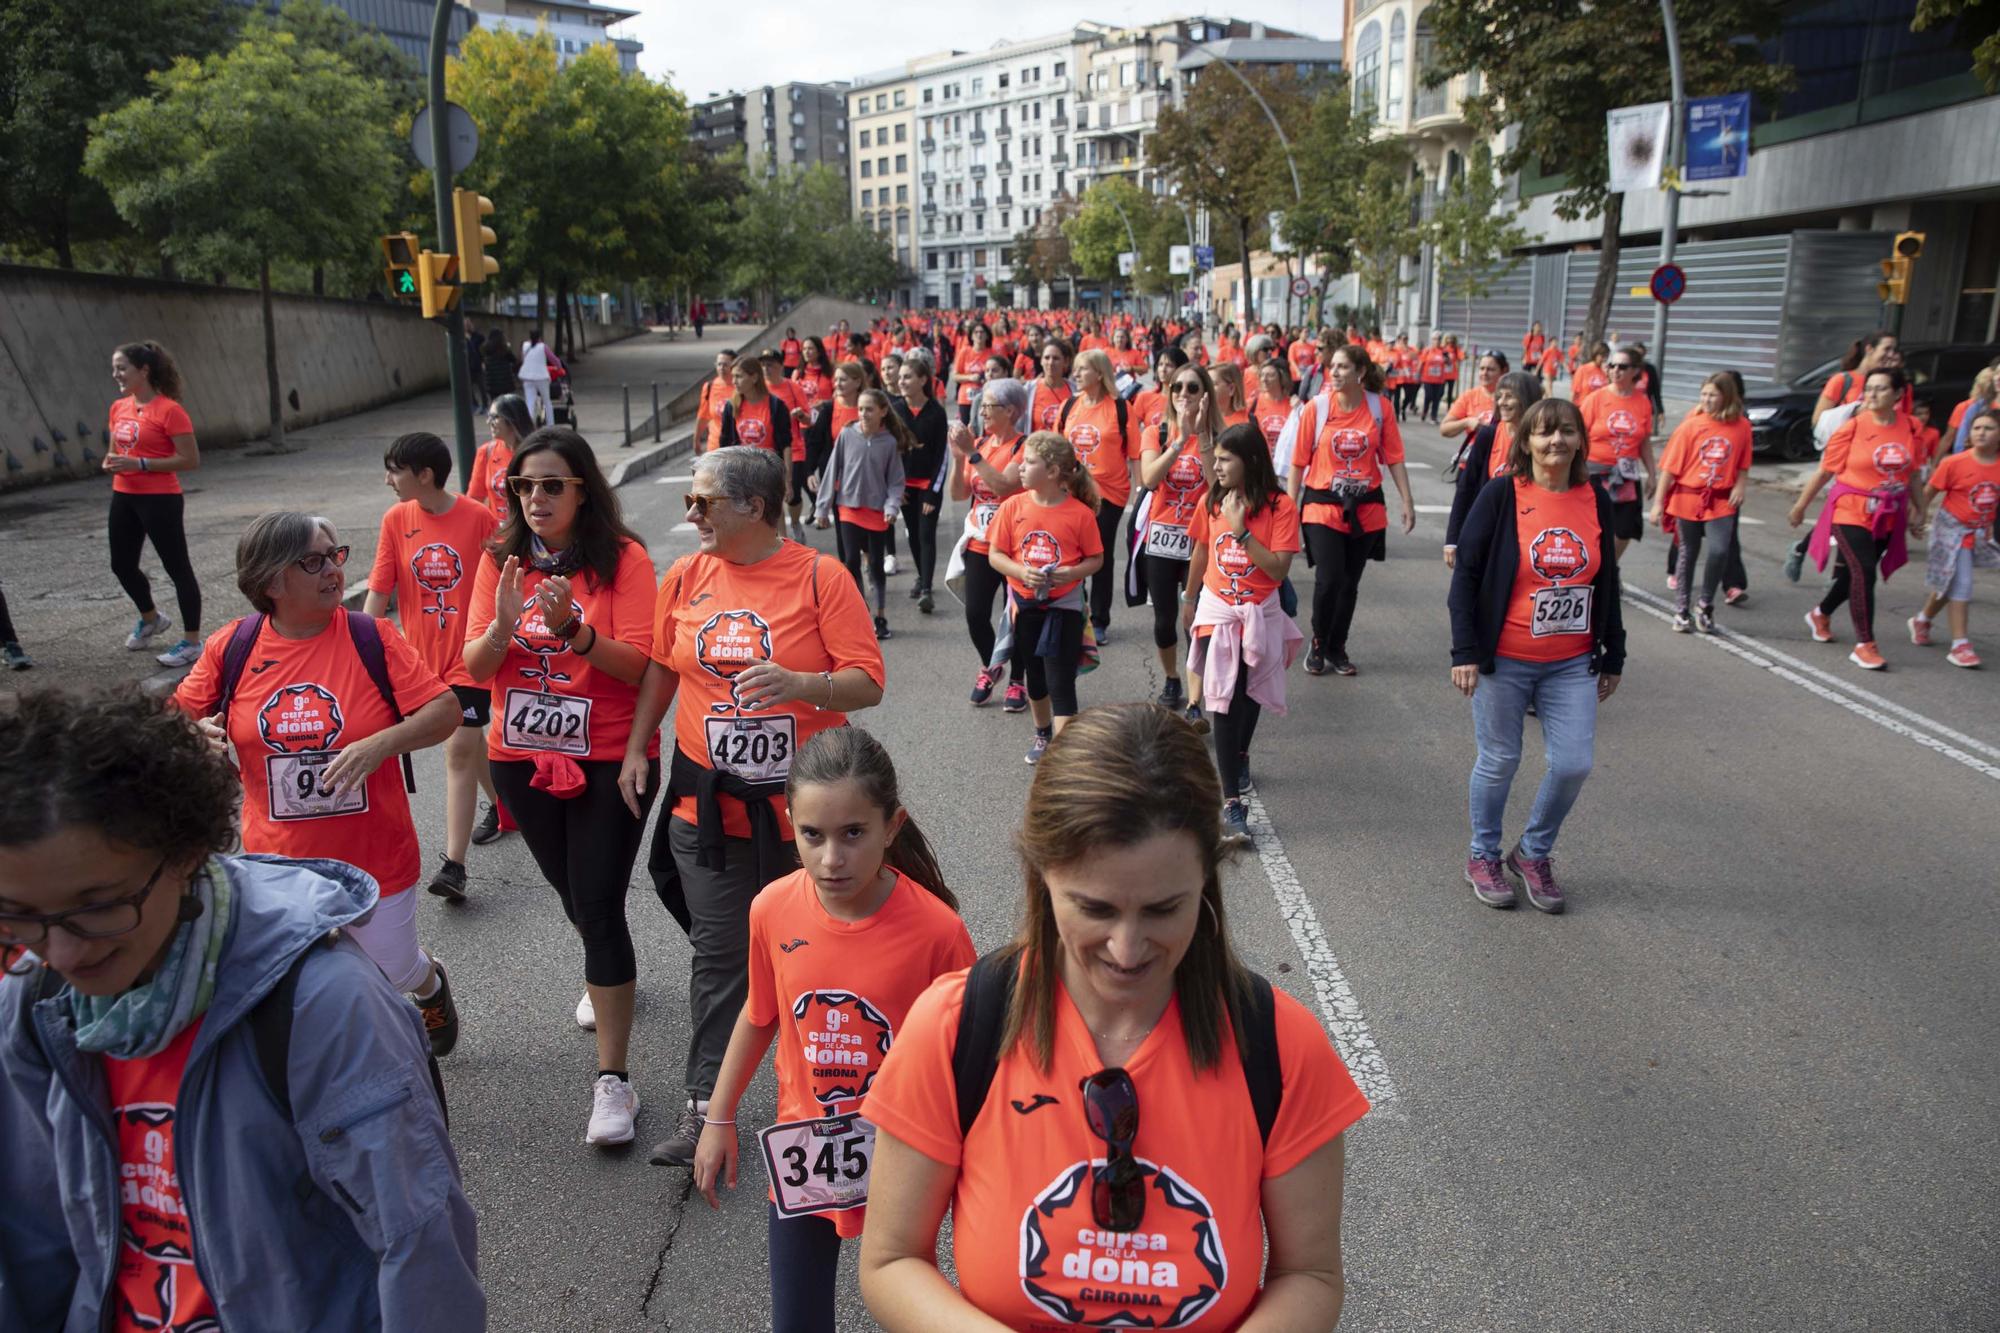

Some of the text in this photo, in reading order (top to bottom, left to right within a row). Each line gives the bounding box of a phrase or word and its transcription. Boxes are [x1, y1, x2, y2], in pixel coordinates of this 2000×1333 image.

[1151, 530, 1189, 550] 2078
[1220, 553, 1249, 564] dona
[1543, 554, 1576, 565] dona
[422, 567, 452, 577] dona
[1536, 597, 1586, 622] 5226
[716, 635, 751, 643] cursa
[710, 643, 754, 658] dona
[281, 710, 319, 719] cursa
[276, 719, 325, 734] dona
[510, 706, 582, 740] 4202
[285, 733, 319, 742] GIRONA
[714, 731, 789, 765] 4203
[808, 1031, 863, 1046] cursa
[803, 1044, 869, 1066] dona
[812, 1067, 859, 1078] GIRONA
[1077, 1228, 1168, 1251] cursa
[1105, 1249, 1138, 1260] DE LA
[1061, 1247, 1179, 1288] dona
[1079, 1287, 1163, 1306] GIRONA
